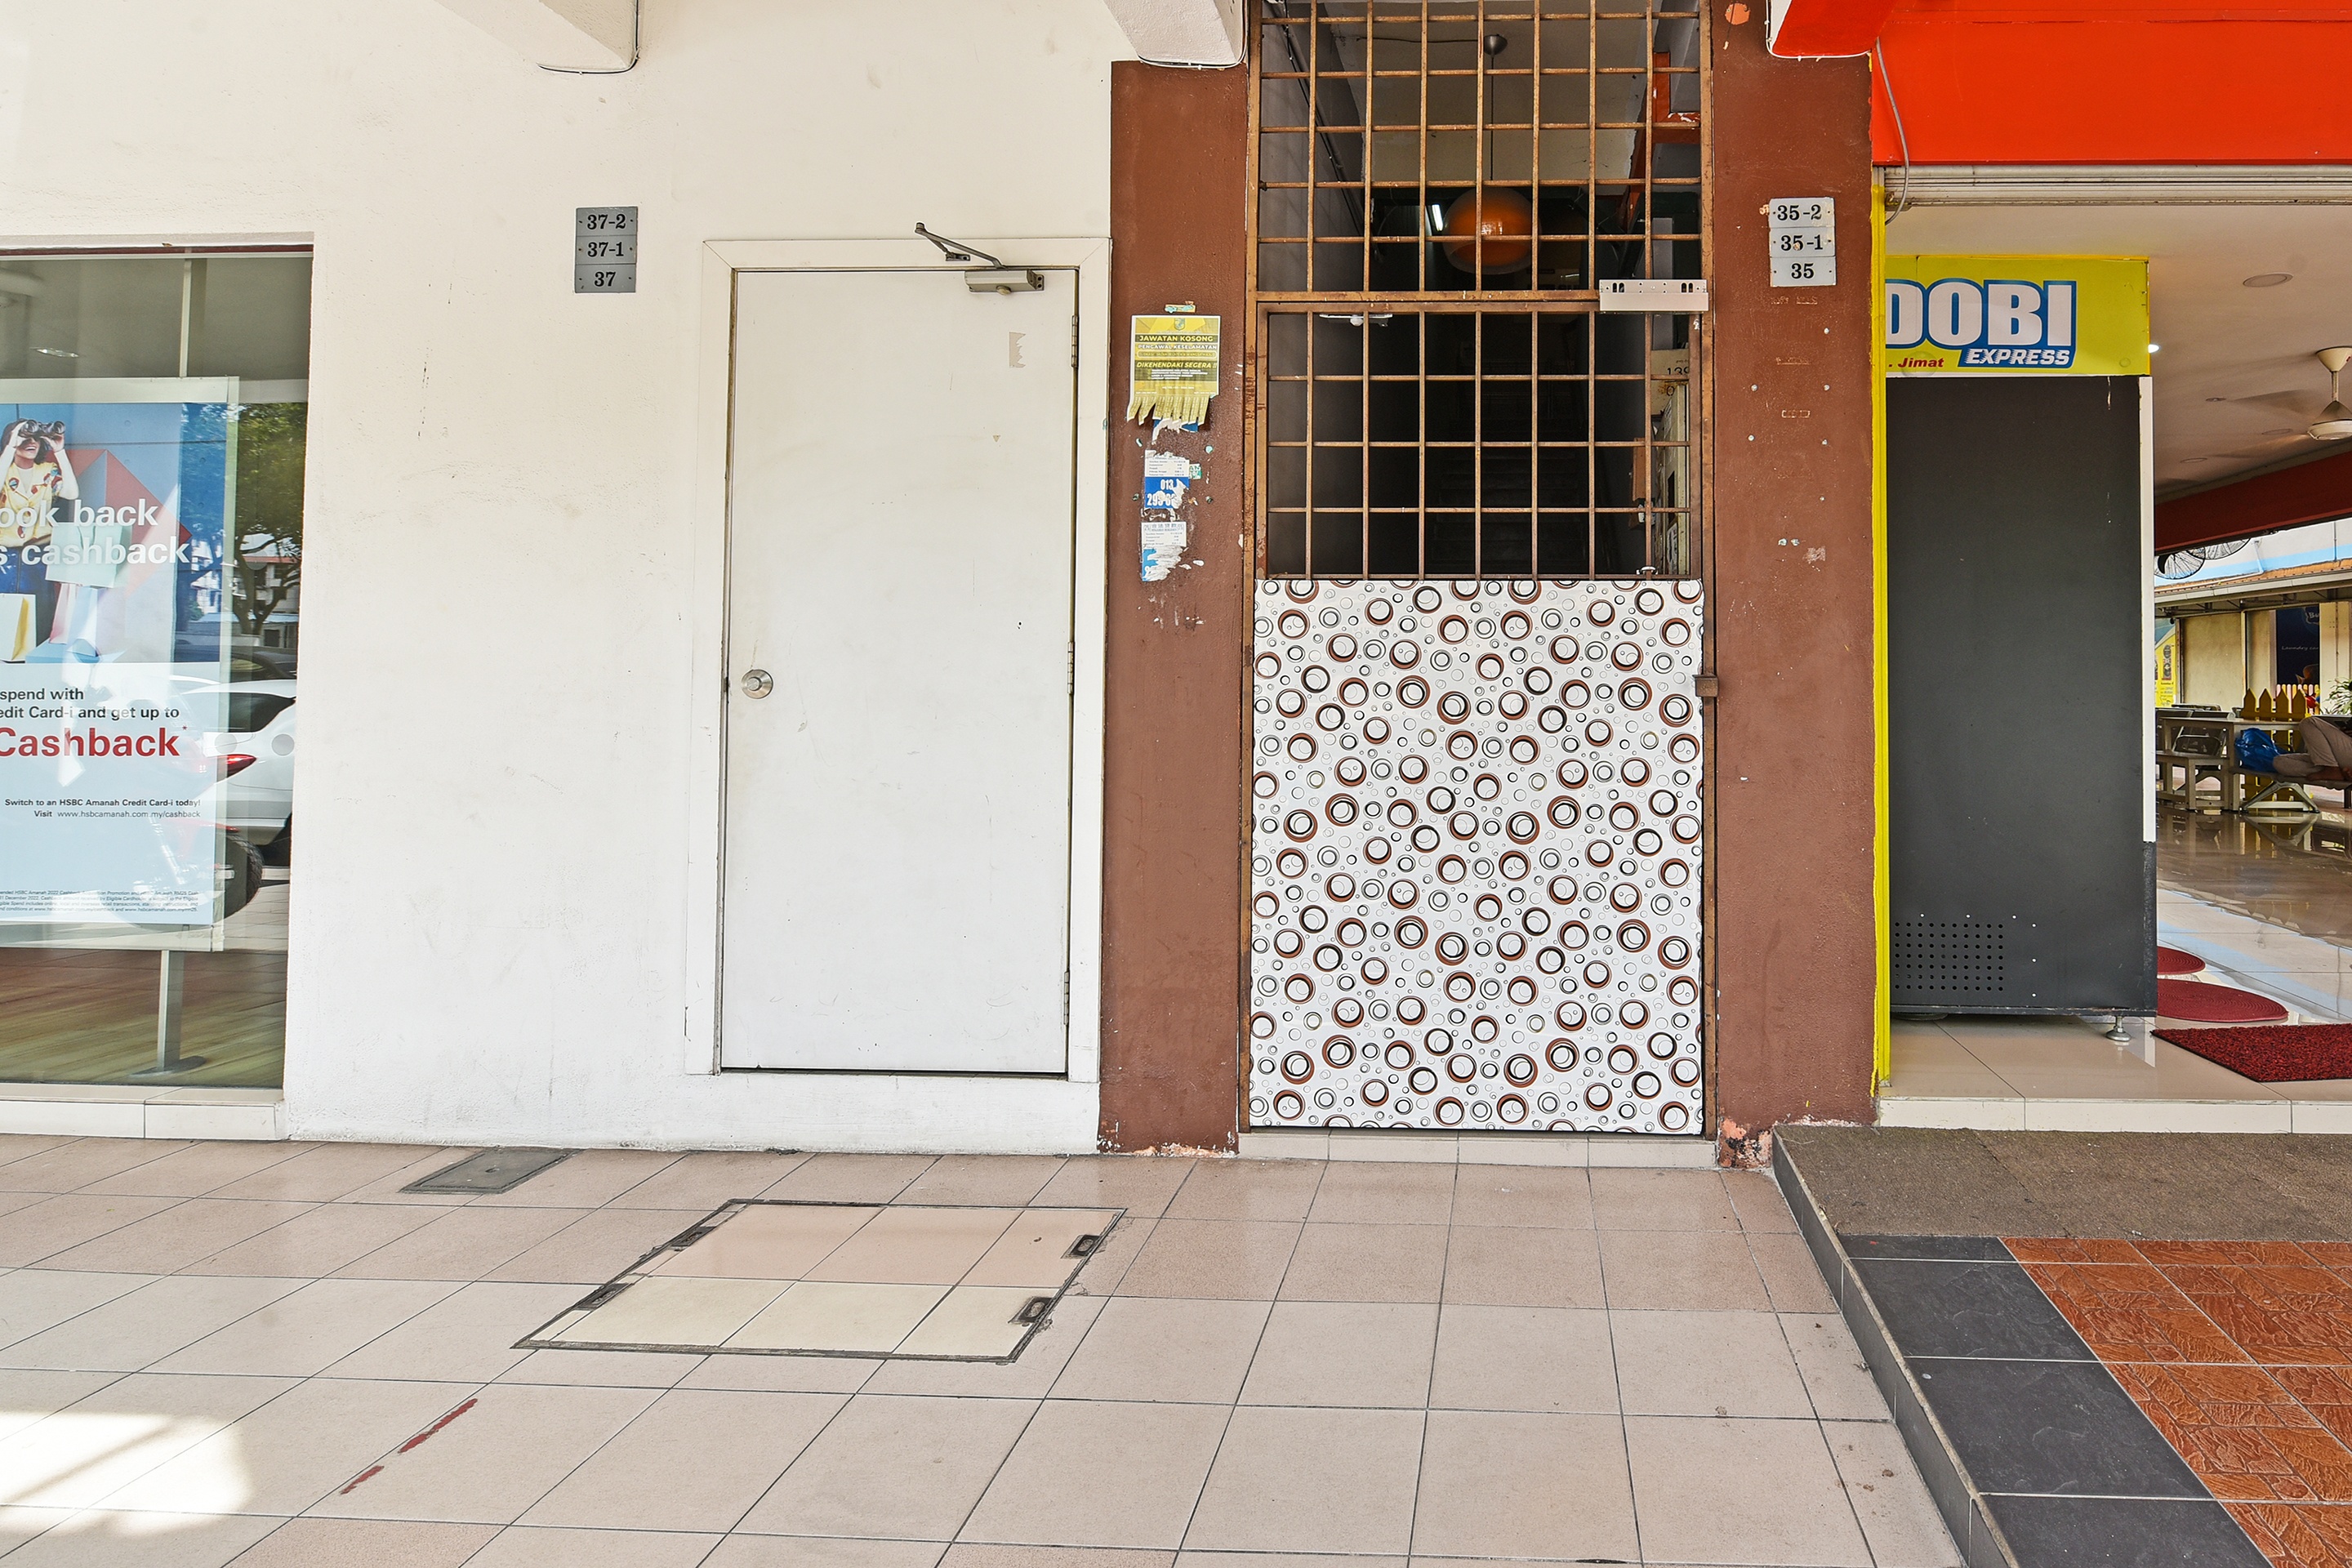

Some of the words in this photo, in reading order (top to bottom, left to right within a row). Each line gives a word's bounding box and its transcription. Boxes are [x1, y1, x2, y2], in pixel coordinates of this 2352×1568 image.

[1777, 204, 1822, 220] 35-2
[586, 213, 626, 230] 37-2
[587, 241, 624, 257] 37-1
[1780, 234, 1824, 251] 35-1
[594, 271, 617, 287] 37
[1791, 263, 1815, 279] 35
[1885, 280, 2075, 348] DOBI
[1897, 358, 1944, 368] Jimat
[1964, 348, 2071, 366] EXPRESS
[74, 499, 158, 527] back
[0, 688, 45, 702] spend
[50, 688, 84, 700] with
[29, 706, 73, 719] Card-i
[78, 706, 106, 719] and
[111, 707, 136, 721] get
[140, 708, 160, 721] up
[165, 708, 180, 718] to
[5, 799, 33, 807] Switch
[59, 799, 83, 807] HSBC
[85, 799, 120, 807] Amanah
[122, 799, 147, 807] Credit
[149, 799, 173, 807] Card-i
[176, 799, 201, 808] today!
